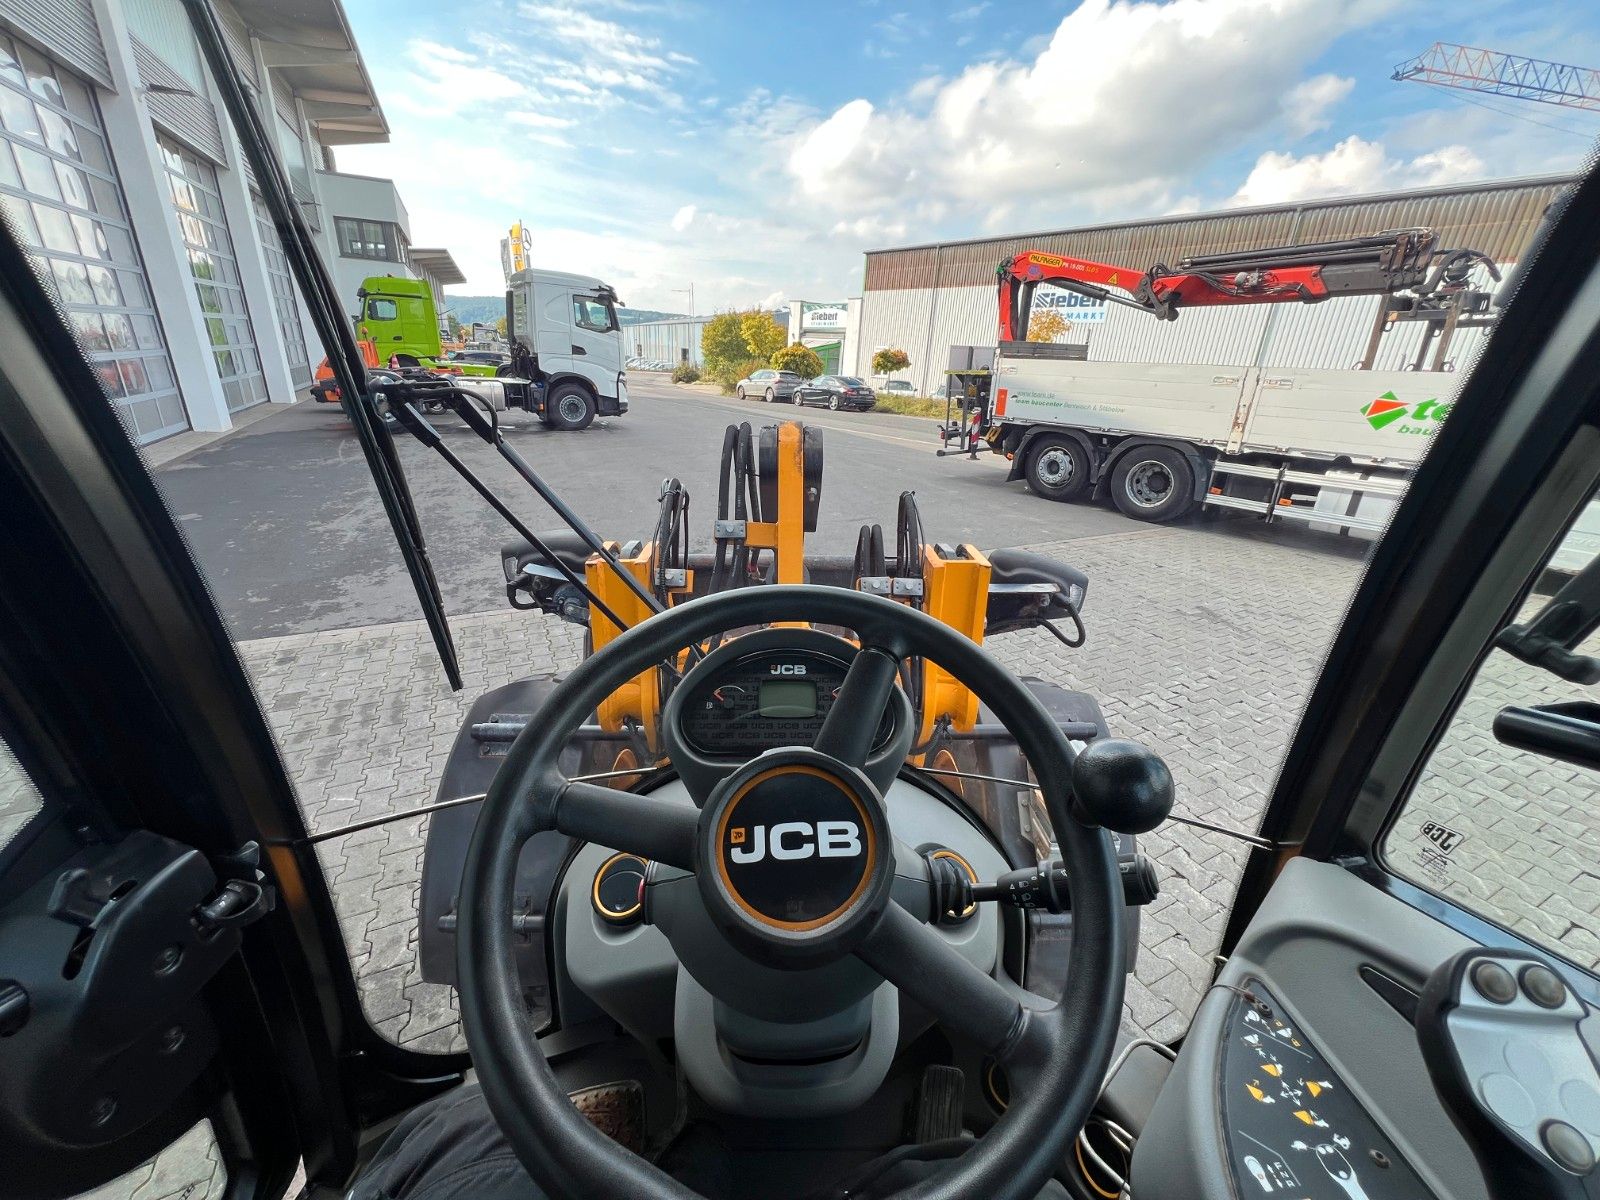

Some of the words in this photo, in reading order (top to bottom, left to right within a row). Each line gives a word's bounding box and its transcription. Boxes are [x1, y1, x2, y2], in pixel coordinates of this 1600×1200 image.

[1030, 255, 1061, 267] PALFINGER
[770, 664, 807, 675] JCB
[730, 820, 862, 864] JCB
